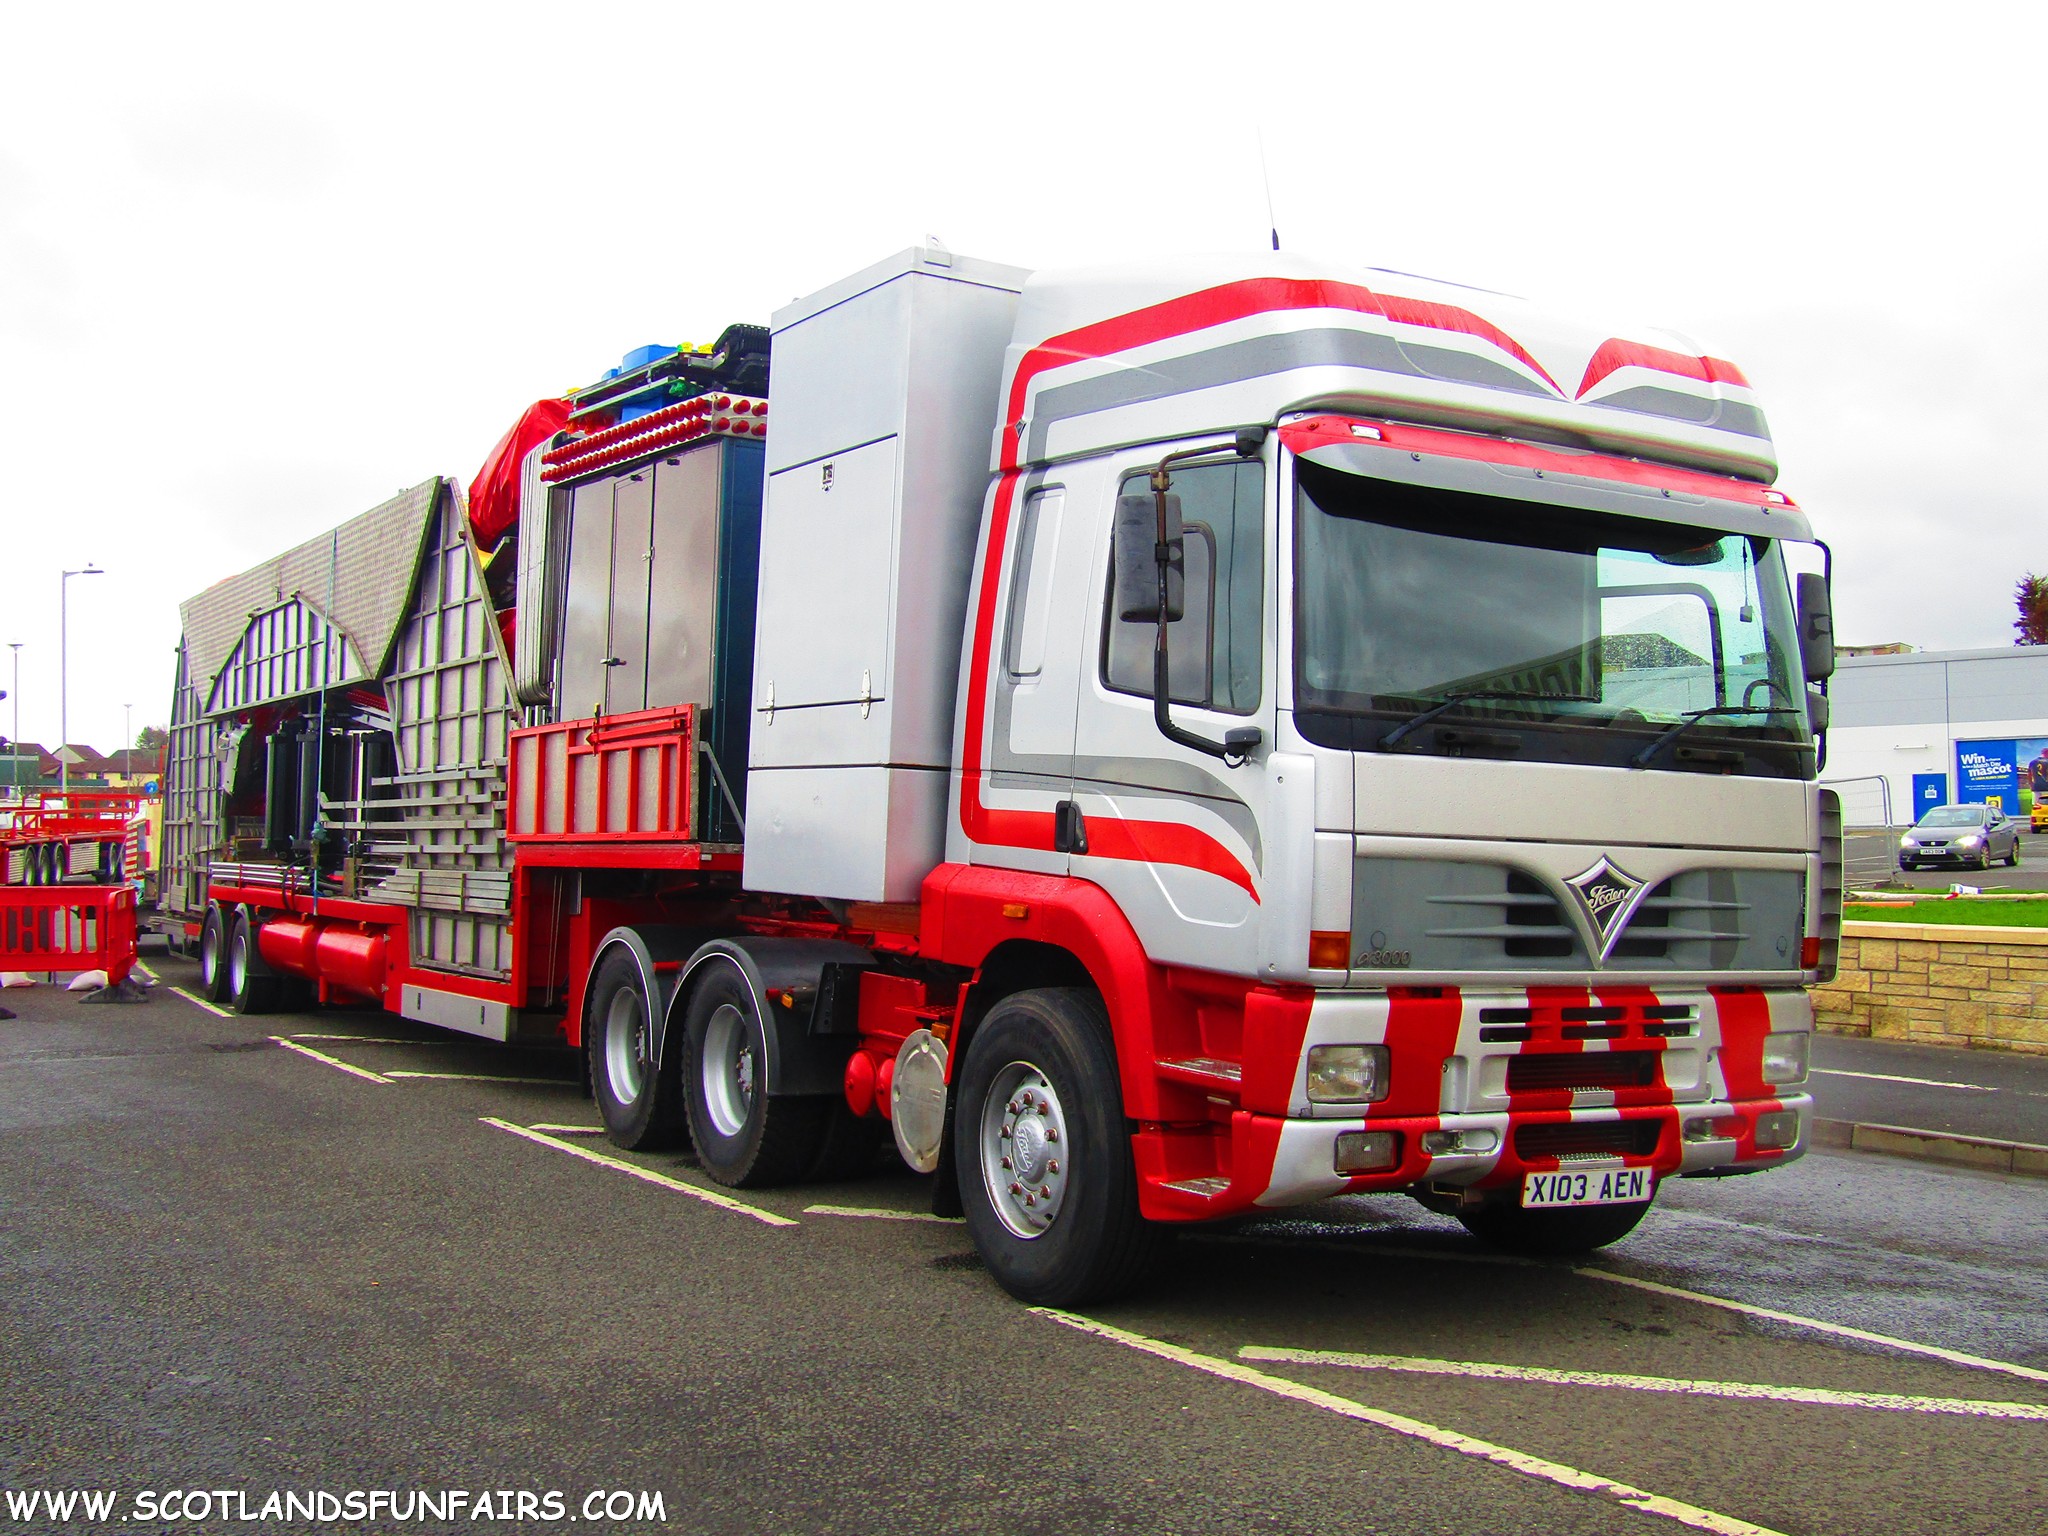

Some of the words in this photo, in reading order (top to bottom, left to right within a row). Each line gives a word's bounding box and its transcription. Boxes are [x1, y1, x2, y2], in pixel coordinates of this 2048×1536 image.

[1960, 753, 1985, 765] Win
[1968, 763, 2012, 777] mascot
[1588, 884, 1626, 909] Foden
[1531, 1174, 1588, 1203] X103
[1599, 1170, 1644, 1199] AEN
